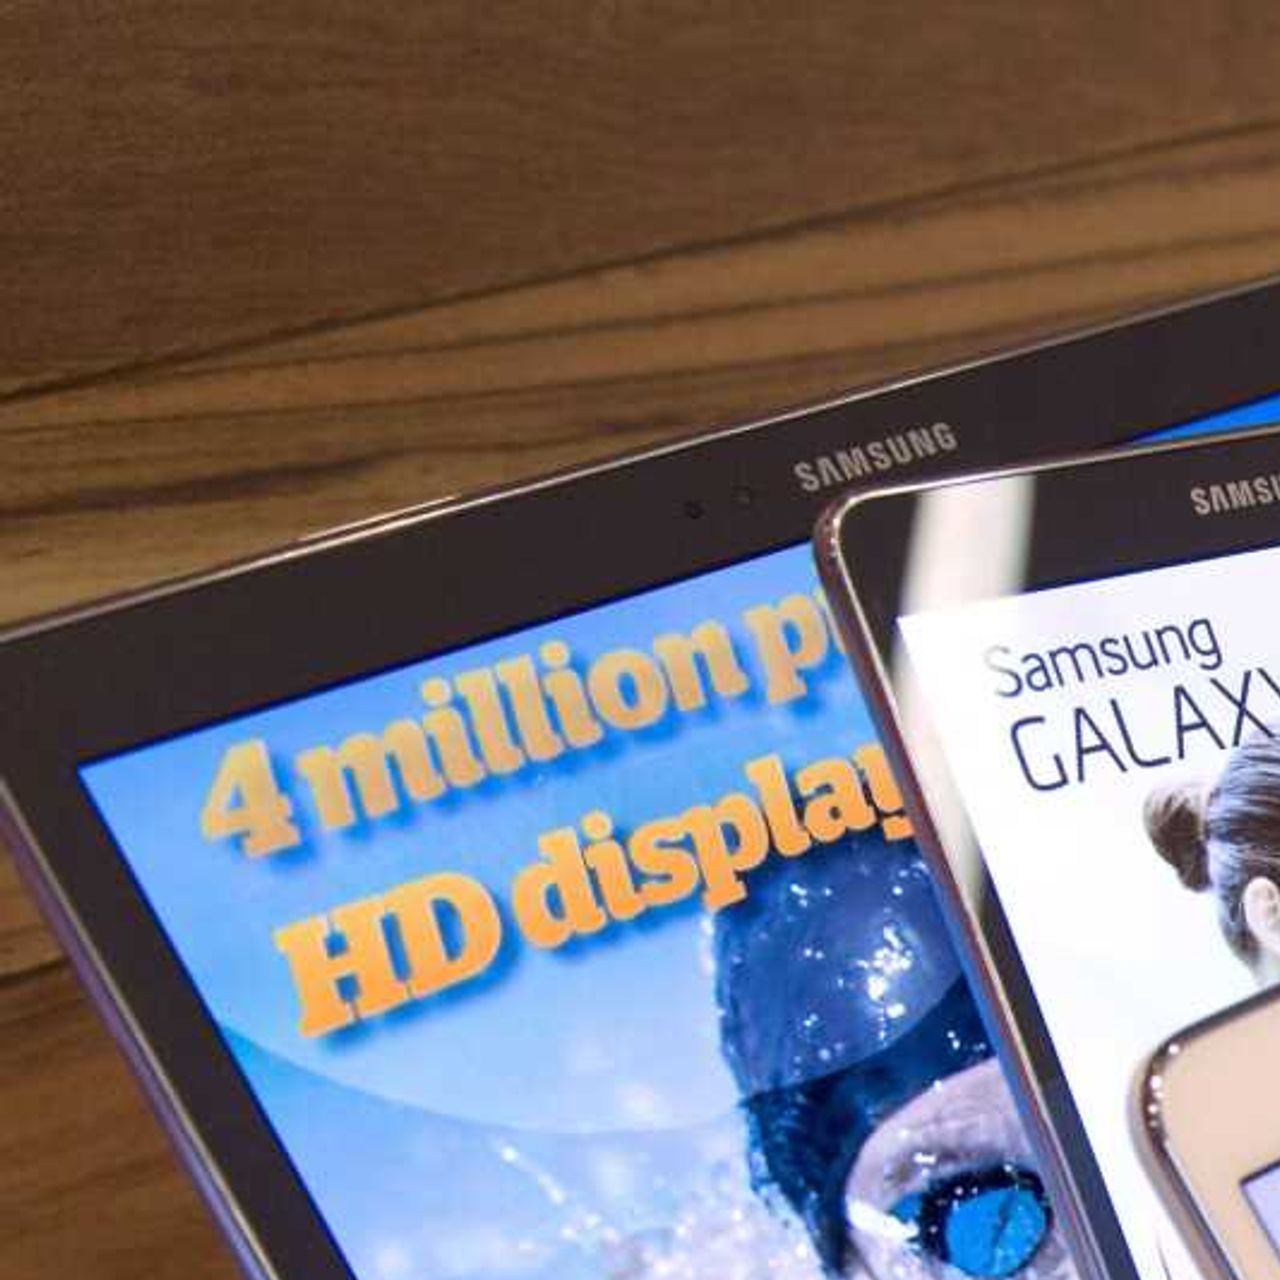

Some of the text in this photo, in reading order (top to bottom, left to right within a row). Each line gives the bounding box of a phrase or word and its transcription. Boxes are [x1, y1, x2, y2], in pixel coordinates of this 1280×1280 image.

[793, 421, 959, 493] SAMSUNG
[984, 617, 1223, 699] Samsung
[202, 740, 299, 858] 4
[299, 620, 748, 829] million
[273, 872, 501, 1038] HD
